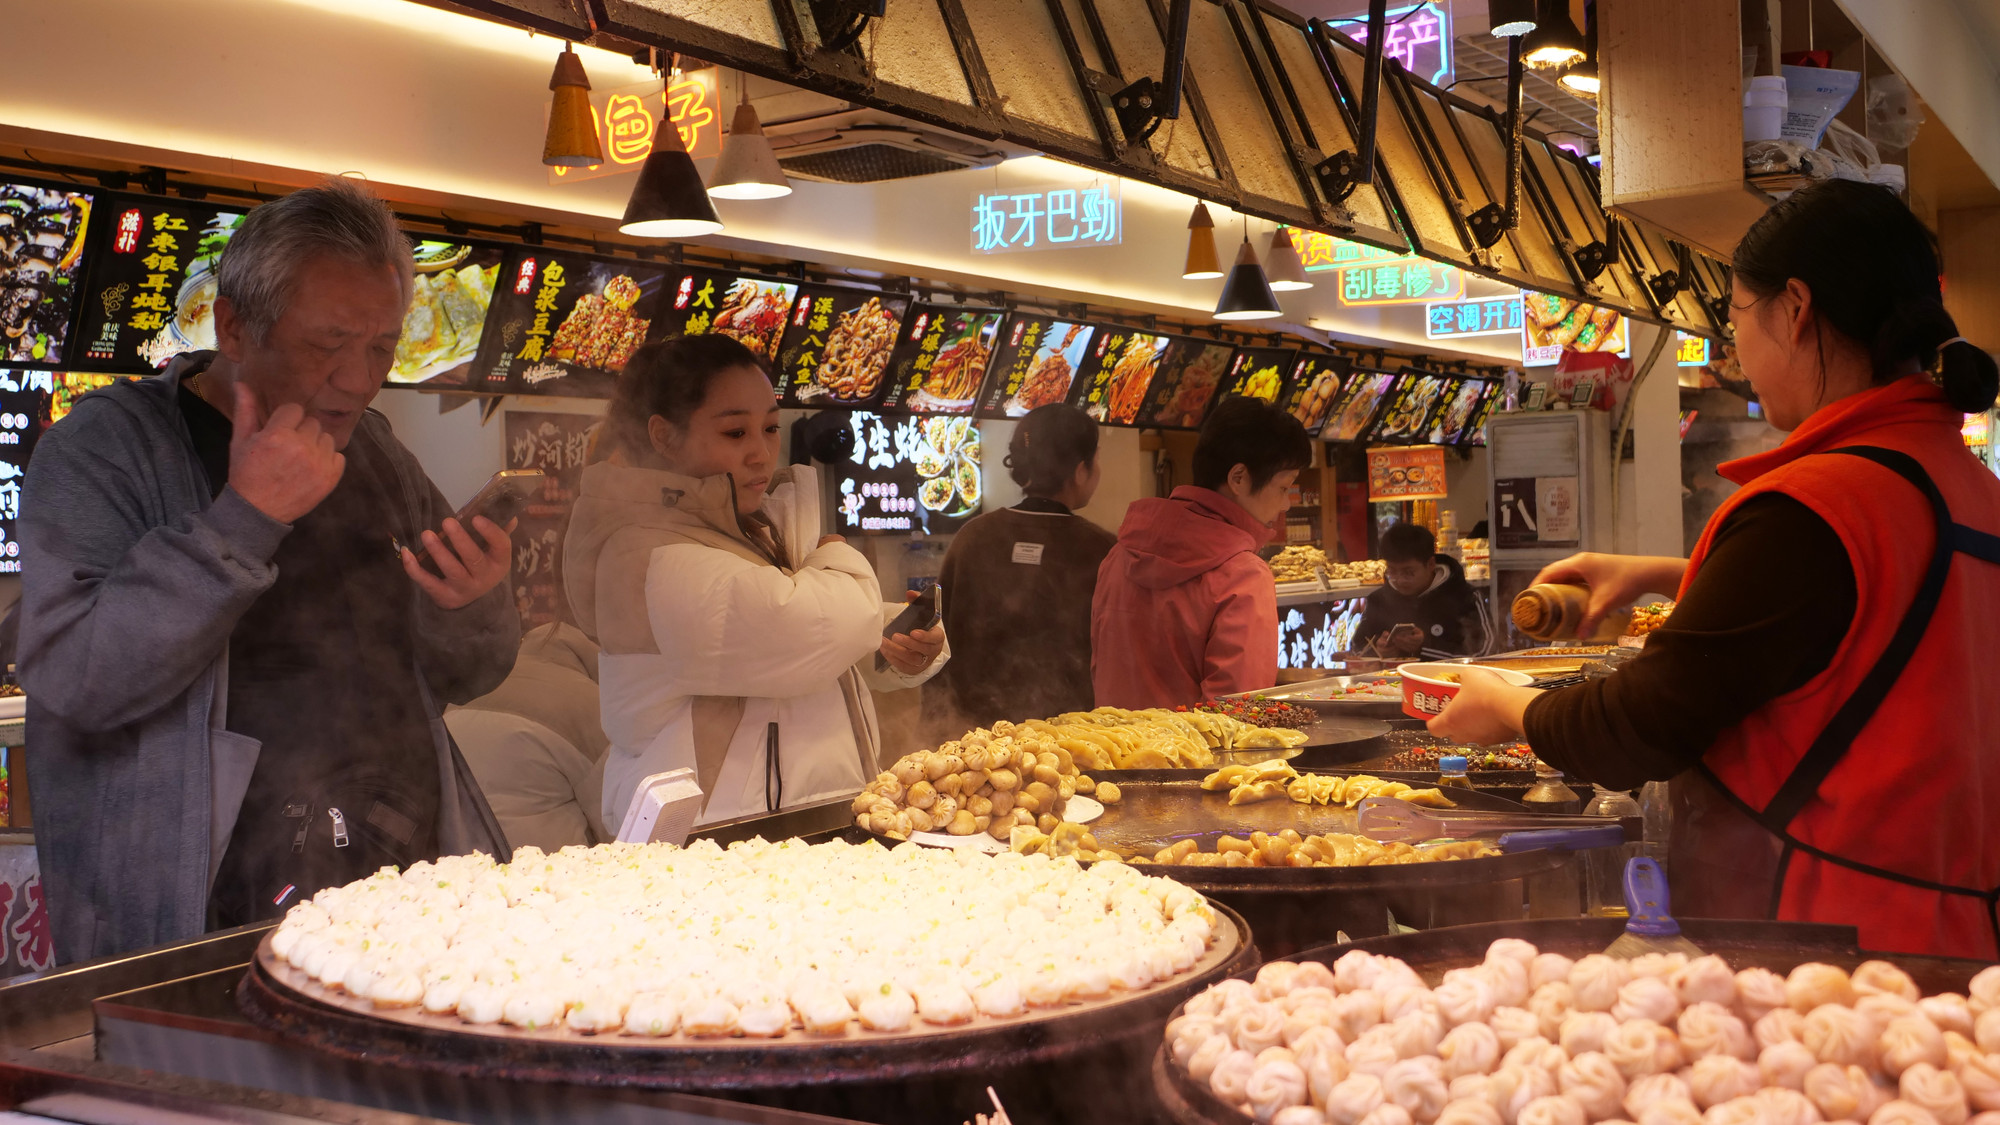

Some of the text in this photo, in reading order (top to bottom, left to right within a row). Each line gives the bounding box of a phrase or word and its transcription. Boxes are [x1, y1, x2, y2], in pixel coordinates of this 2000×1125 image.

[553, 80, 713, 177] 色子
[516, 260, 535, 293] 经典
[1344, 264, 1456, 299] 刮毒惨了
[515, 260, 566, 362] 包浆豆腐
[793, 297, 834, 384] 深海八爪鱼
[1677, 338, 1705, 362] 起
